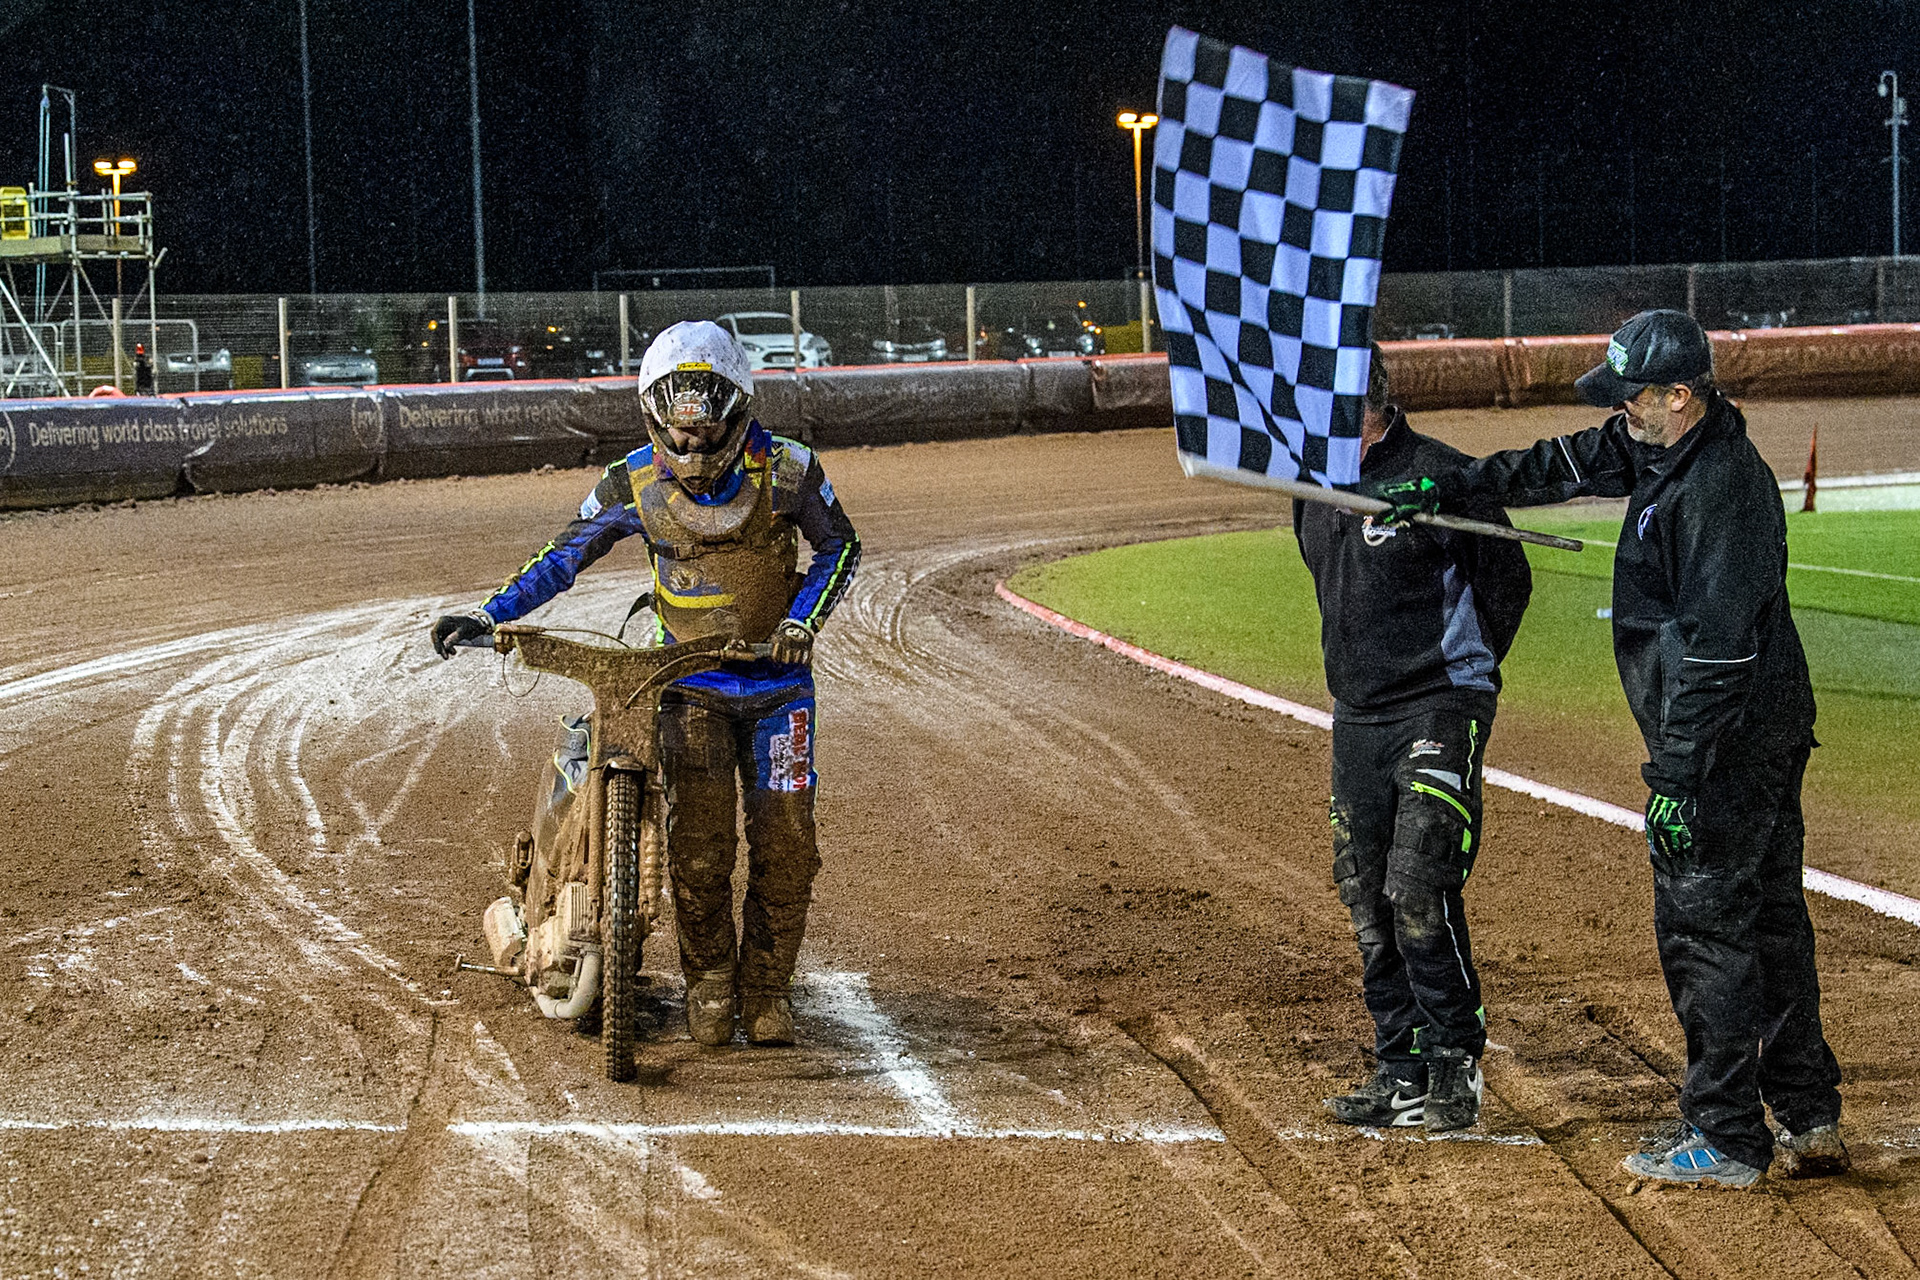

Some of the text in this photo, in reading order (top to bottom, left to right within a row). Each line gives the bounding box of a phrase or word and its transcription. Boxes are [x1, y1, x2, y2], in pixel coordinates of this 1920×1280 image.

[28, 413, 288, 450] Delivering world class travel solutions
[399, 402, 479, 432] Delivering
